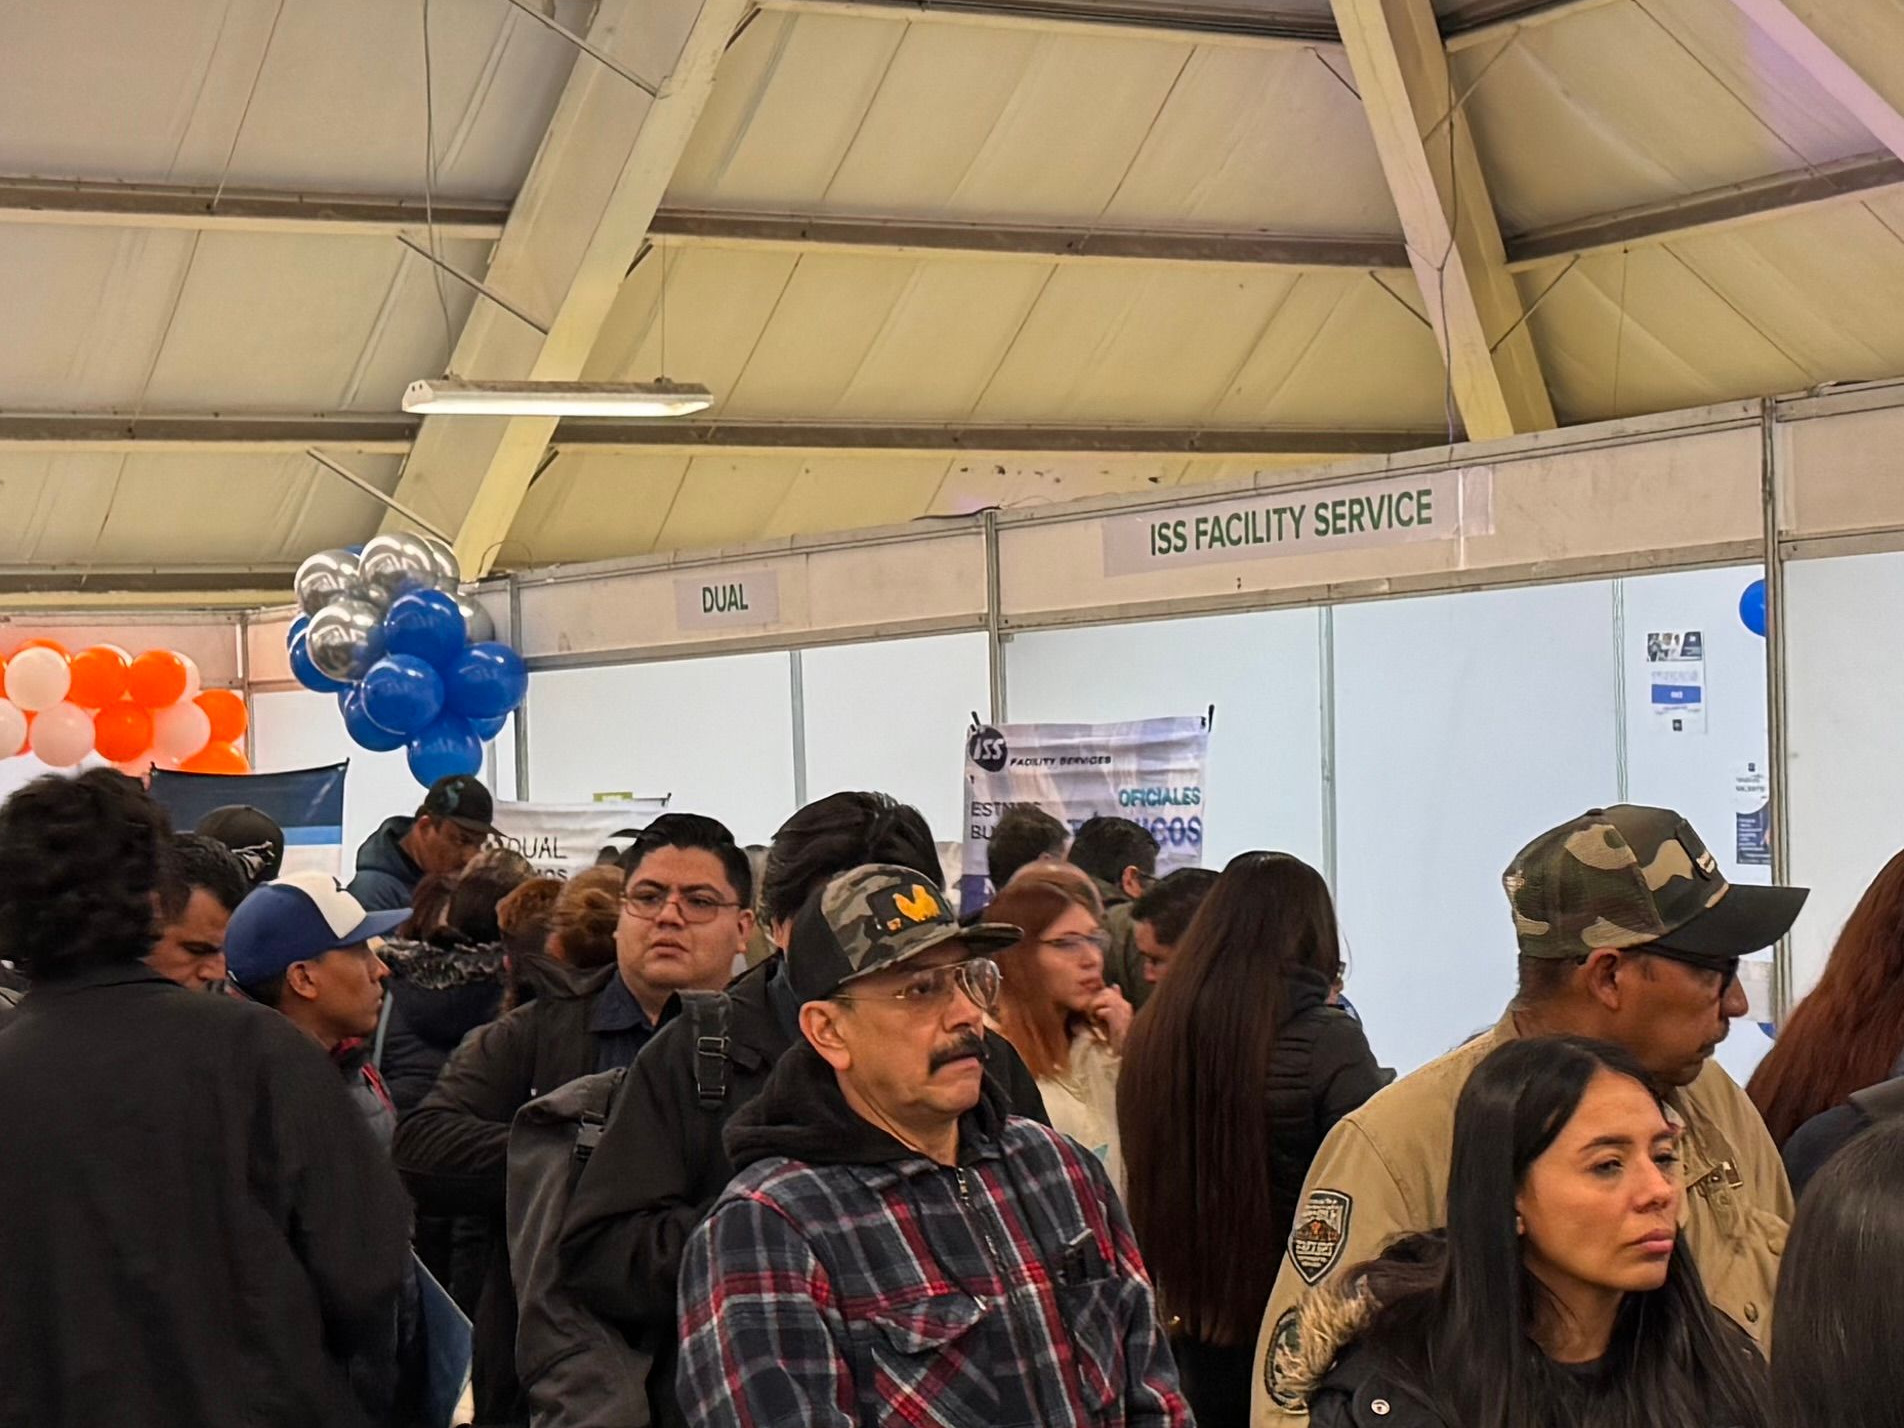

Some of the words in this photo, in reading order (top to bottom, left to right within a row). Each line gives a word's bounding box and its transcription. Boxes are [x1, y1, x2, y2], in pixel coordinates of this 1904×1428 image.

[1150, 521, 1187, 556] ISS
[1195, 504, 1306, 551] FACILITY
[1314, 489, 1433, 538] SERVICE
[702, 584, 748, 613] DUAL
[974, 738, 1004, 760] ISS
[1119, 786, 1201, 807] OFICIALES
